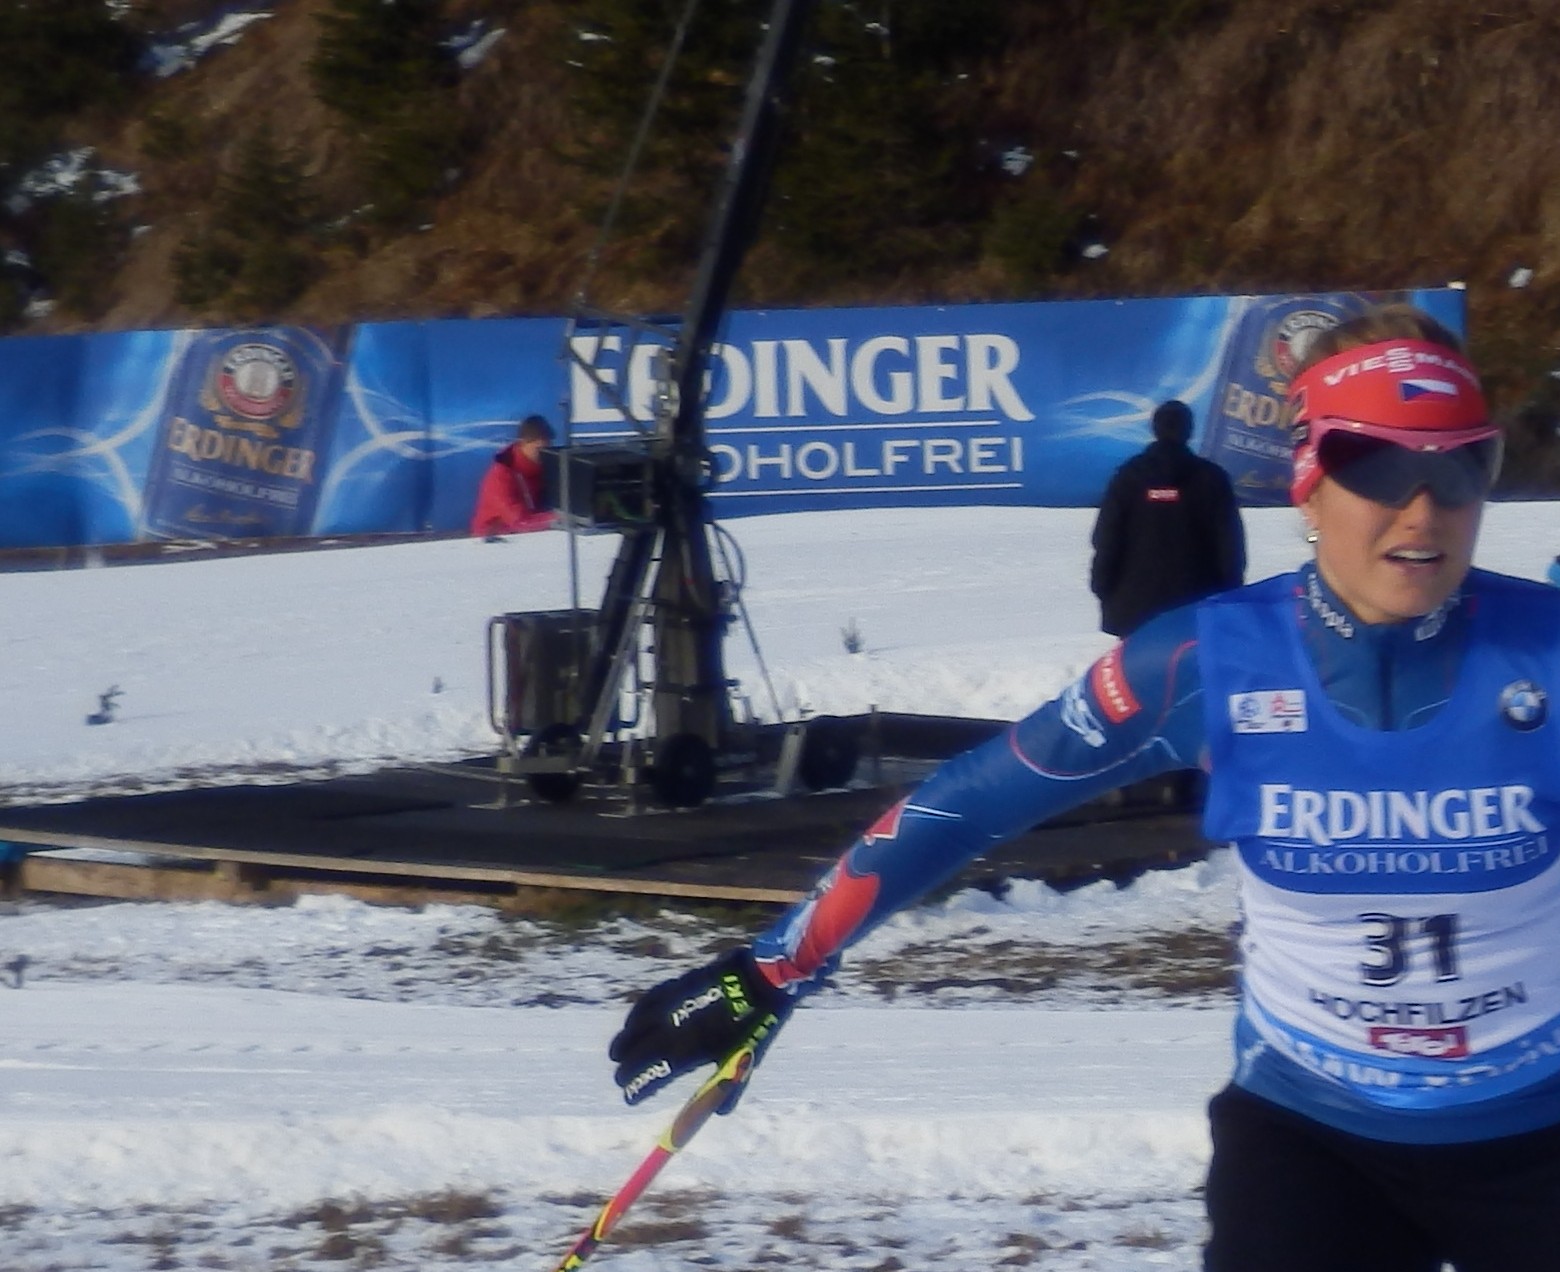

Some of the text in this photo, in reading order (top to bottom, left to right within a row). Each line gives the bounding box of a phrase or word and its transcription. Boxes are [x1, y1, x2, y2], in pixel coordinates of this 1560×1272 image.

[703, 436, 1022, 484] OHOLFREI
[1256, 783, 1548, 847] ERDINGER
[1260, 836, 1549, 875] ALKOHOLFREI
[1356, 912, 1462, 988] 31
[1307, 981, 1528, 1025] HOCHFILZEN
